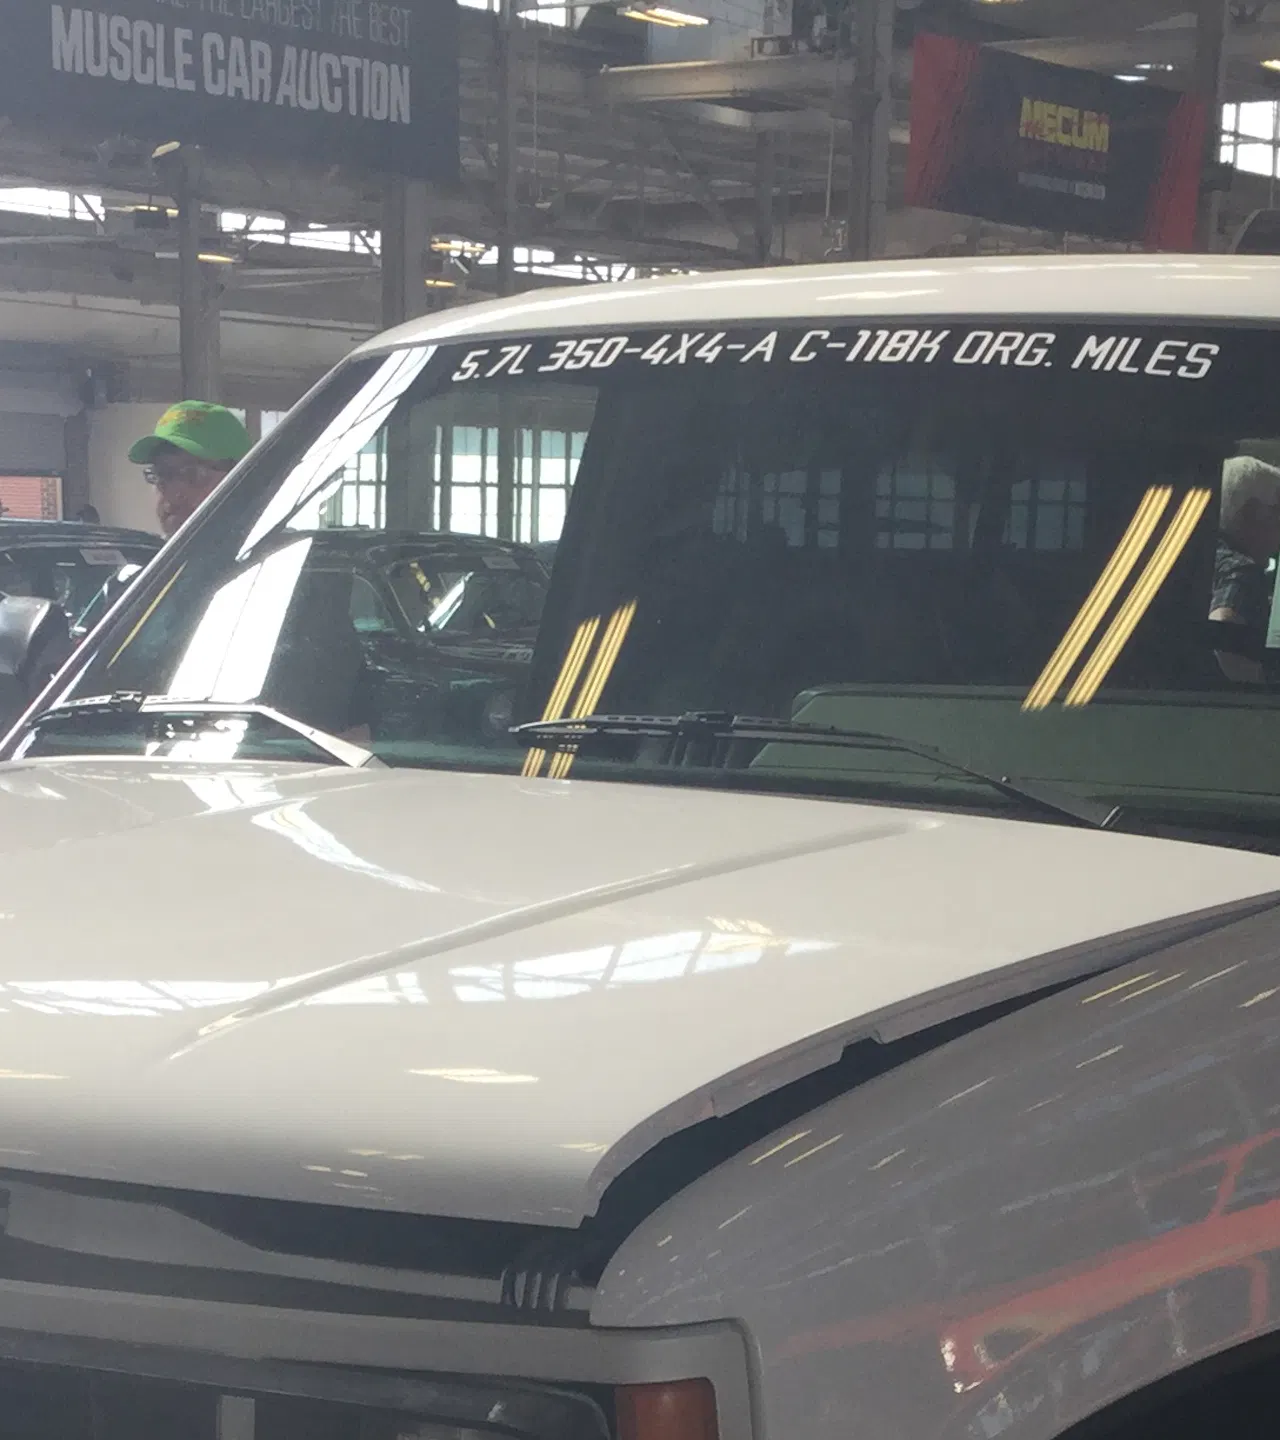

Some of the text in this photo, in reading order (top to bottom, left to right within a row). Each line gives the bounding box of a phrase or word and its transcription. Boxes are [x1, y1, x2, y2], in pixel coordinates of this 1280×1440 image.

[370, 2, 414, 49] BEST
[51, 5, 196, 91] MUSCLE
[202, 32, 270, 103] CAR
[275, 45, 411, 124] AUCTION
[1019, 97, 1110, 153] MECUM
[451, 329, 1220, 382] 5.7L 350-4X4-A C-118K ORG. MILES
